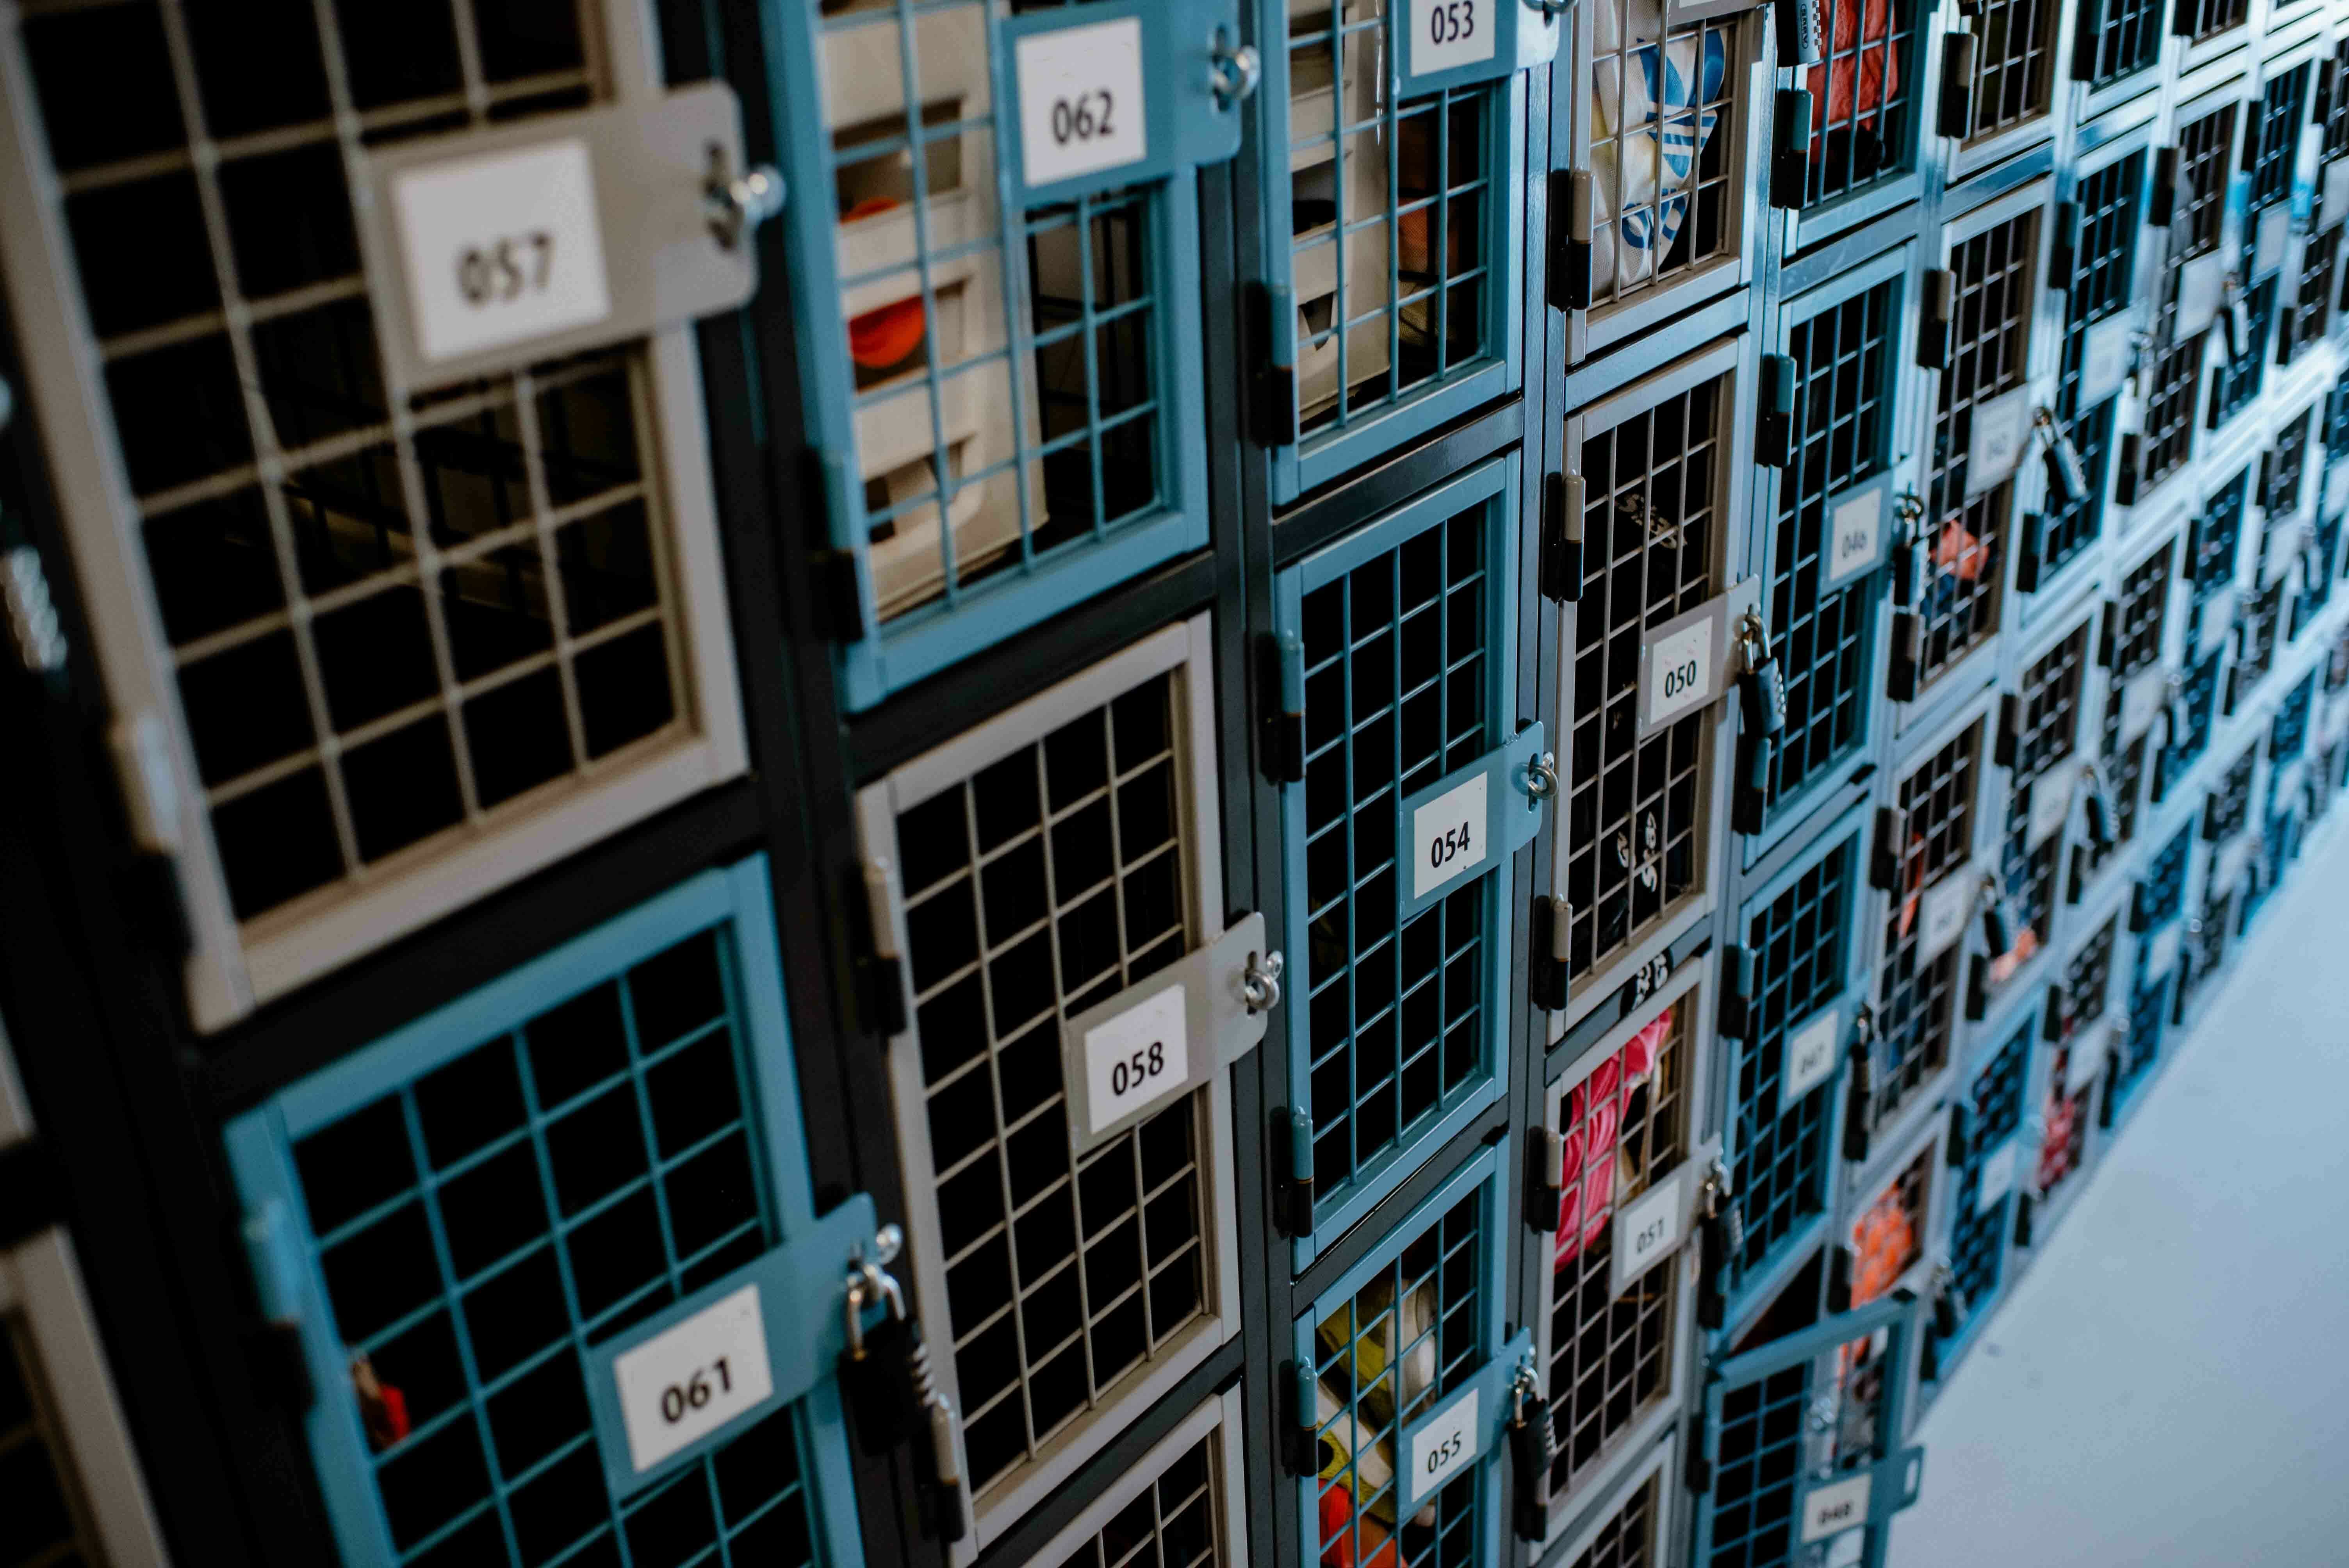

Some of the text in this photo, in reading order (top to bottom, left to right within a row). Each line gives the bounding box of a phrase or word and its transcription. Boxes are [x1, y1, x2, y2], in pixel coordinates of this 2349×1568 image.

[1431, 0, 1474, 45] 053
[1051, 90, 1114, 146] 062
[456, 231, 555, 307] 057
[1665, 660, 1696, 698] 050
[1431, 821, 1470, 868] 054
[1112, 1041, 1165, 1096] 058
[1636, 1215, 1665, 1255] 051
[661, 1356, 733, 1425] 061
[1427, 1430, 1462, 1474] 055
